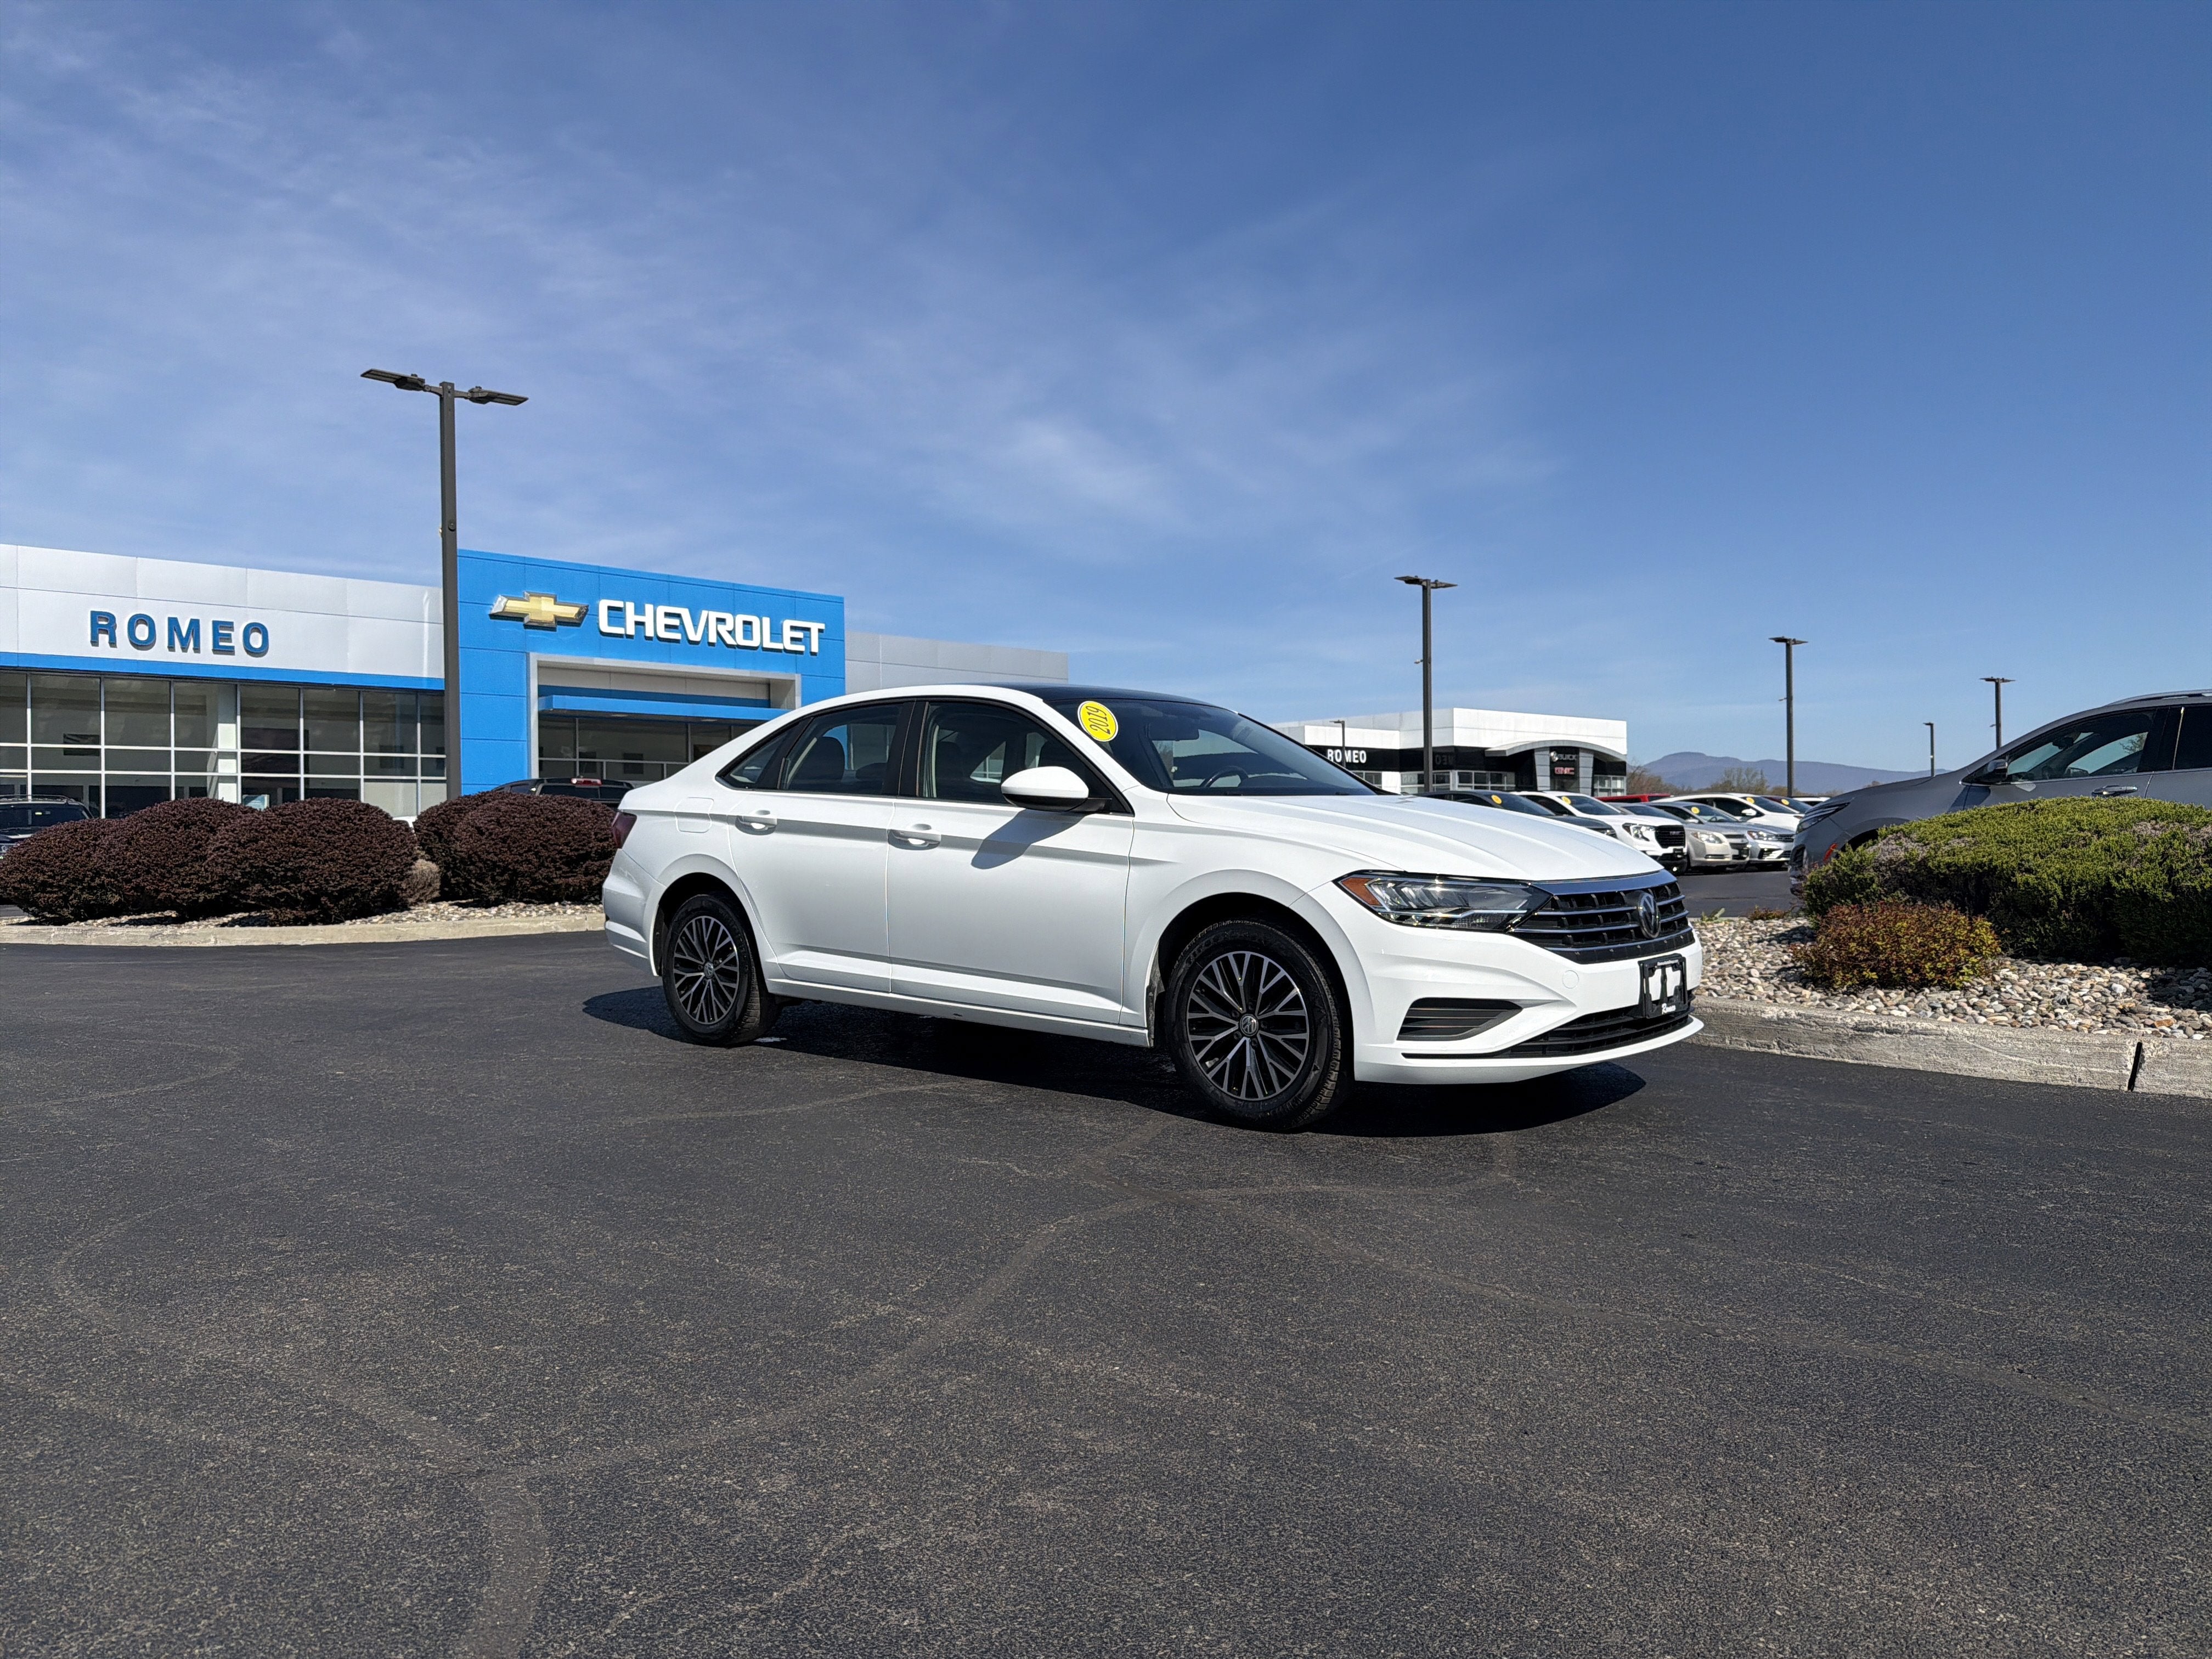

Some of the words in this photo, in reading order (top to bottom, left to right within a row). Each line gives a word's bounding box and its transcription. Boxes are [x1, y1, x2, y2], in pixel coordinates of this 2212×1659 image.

[90, 610, 270, 658] ROMEO
[599, 599, 825, 655] CHEVROLET
[1085, 706, 1110, 735] 2019
[1327, 749, 1367, 763] ROMEO
